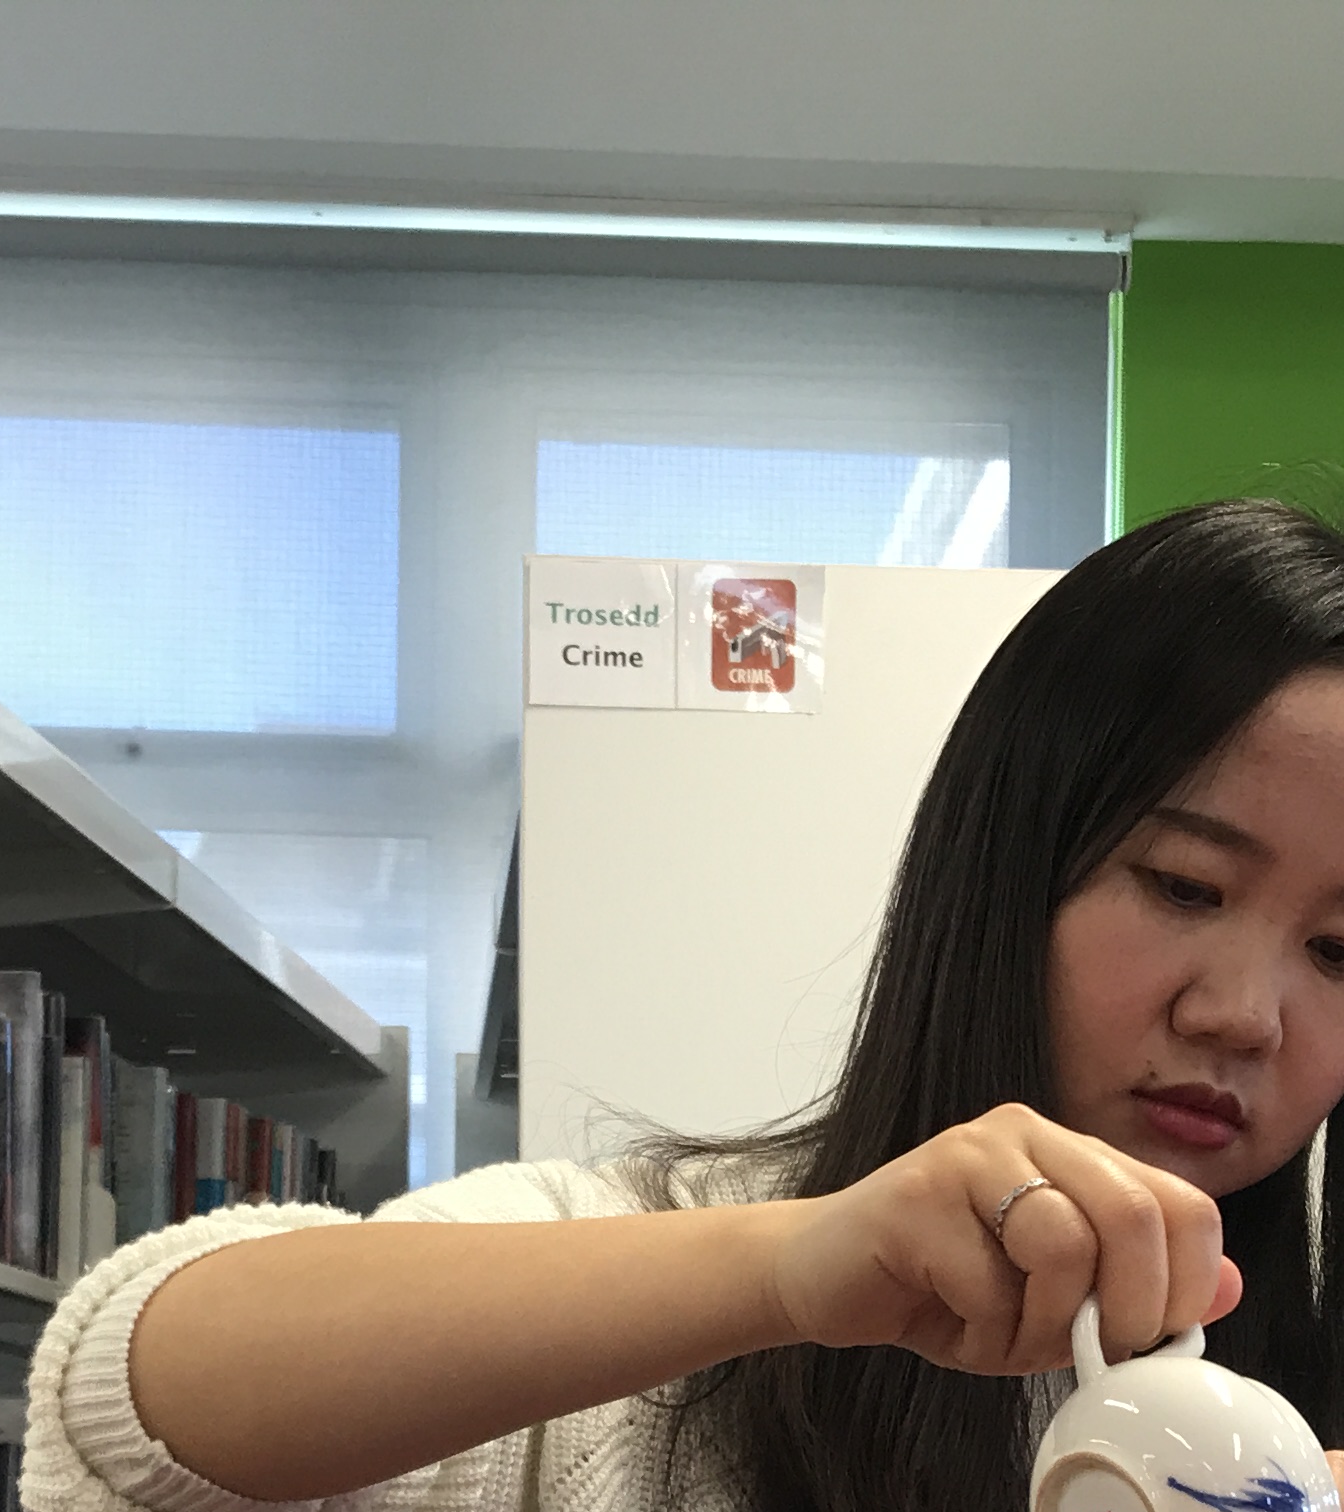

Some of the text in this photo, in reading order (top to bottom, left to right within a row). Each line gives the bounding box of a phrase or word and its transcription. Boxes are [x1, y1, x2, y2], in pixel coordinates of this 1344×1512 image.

[545, 602, 660, 628] Trosedd
[562, 644, 643, 668] Crime
[729, 668, 772, 684] CRIME
